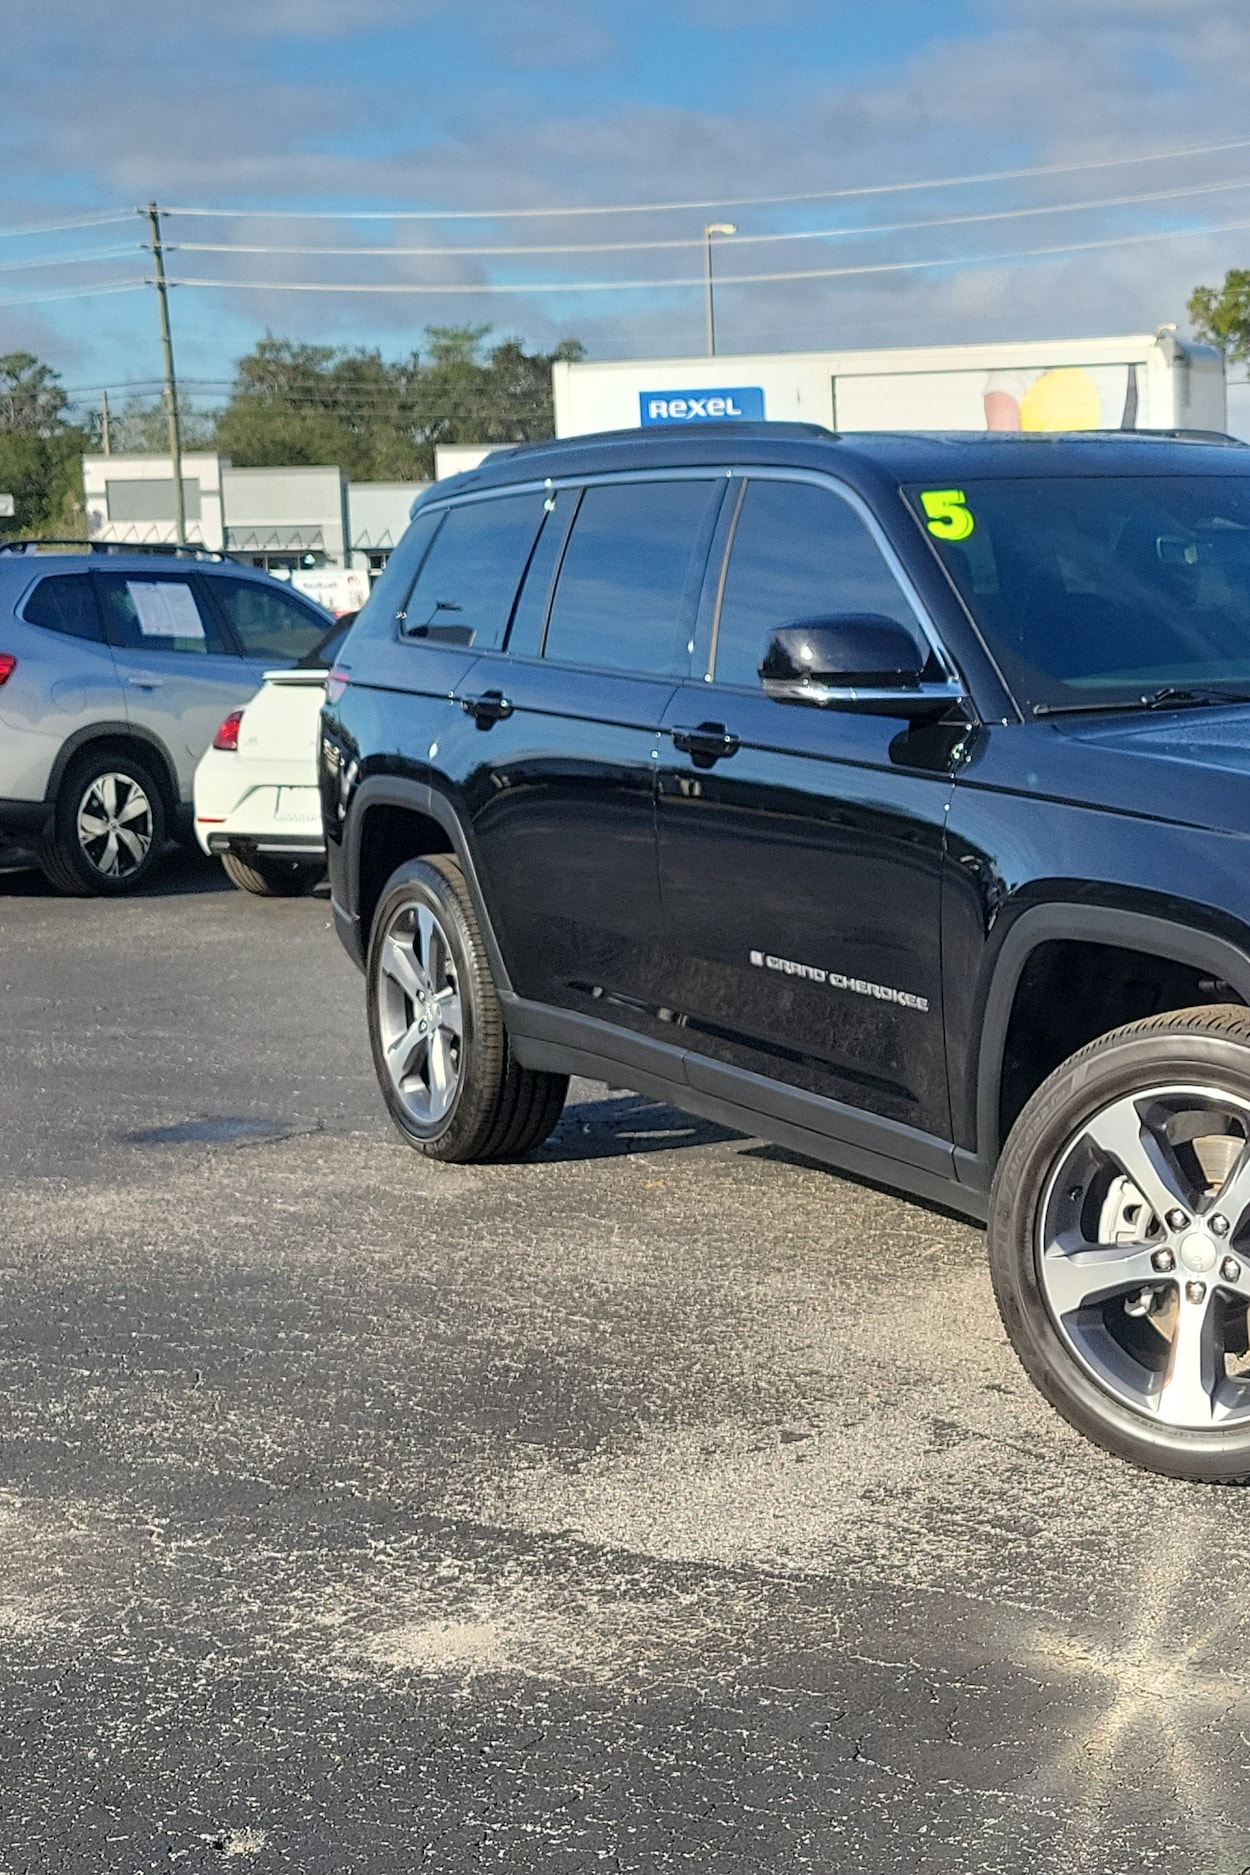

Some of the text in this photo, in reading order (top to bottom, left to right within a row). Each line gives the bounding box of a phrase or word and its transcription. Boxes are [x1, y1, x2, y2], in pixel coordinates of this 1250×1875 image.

[921, 489, 974, 541] 5
[766, 955, 929, 1012] GRAND CHEROKEE
